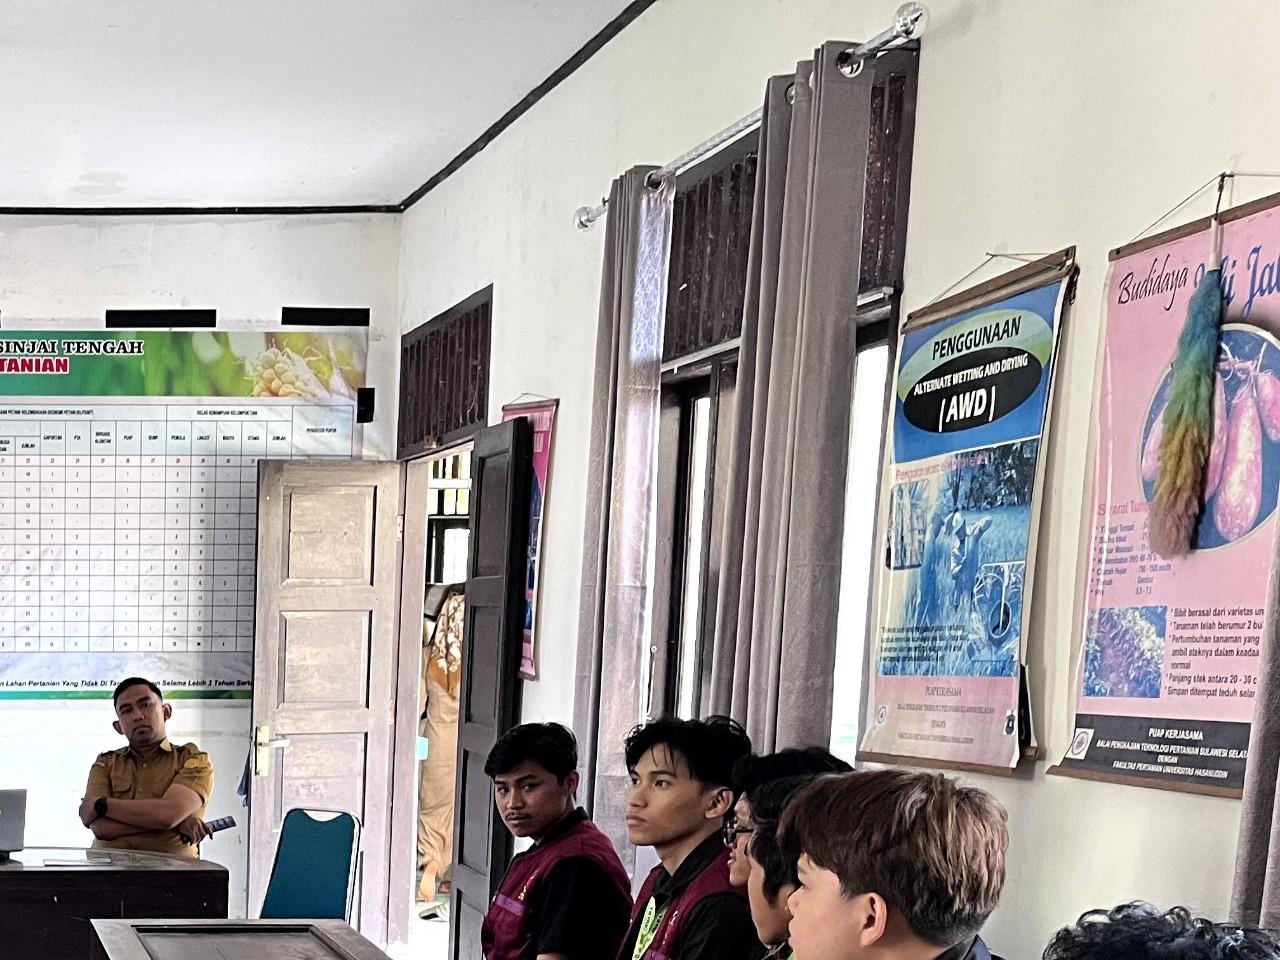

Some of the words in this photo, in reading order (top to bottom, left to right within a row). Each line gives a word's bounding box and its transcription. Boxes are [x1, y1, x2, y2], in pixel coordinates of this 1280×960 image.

[1118, 253, 1188, 311] Budidaya
[932, 316, 1022, 360] PENGGUNAAN
[62, 338, 144, 353] TENGAH
[914, 375, 952, 396] ALTERNATE
[952, 366, 984, 386] WETTING
[984, 362, 1000, 377] AND
[1001, 353, 1029, 373] DRYING
[1174, 608, 1186, 617] Bibit
[1188, 607, 1211, 616] berasal
[1213, 607, 1225, 616] dari
[1227, 607, 1253, 616] varietas
[1173, 621, 1198, 630] Tanaman
[1200, 621, 1216, 630] telah
[1218, 620, 1246, 630] berumur
[1247, 620, 1251, 629] 2
[1172, 634, 1212, 644] Pertumbuhan
[1213, 634, 1242, 643] tanaman
[1243, 635, 1260, 646] yang
[1172, 648, 1187, 656] ambil
[1189, 648, 1213, 658] steknya
[1215, 648, 1235, 656] dalam
[1171, 661, 1191, 669] normal
[1169, 673, 1192, 684] Panjang
[1194, 674, 1206, 682] stek
[1208, 675, 1228, 683] antara
[1229, 675, 1238, 684] 20
[1244, 675, 1251, 684] 30
[1167, 686, 1189, 696] Simpan
[1190, 687, 1217, 697] ditempat
[1219, 687, 1237, 697] teduh
[1149, 728, 1164, 738] PUAP
[1165, 729, 1203, 740] KERJASAMA
